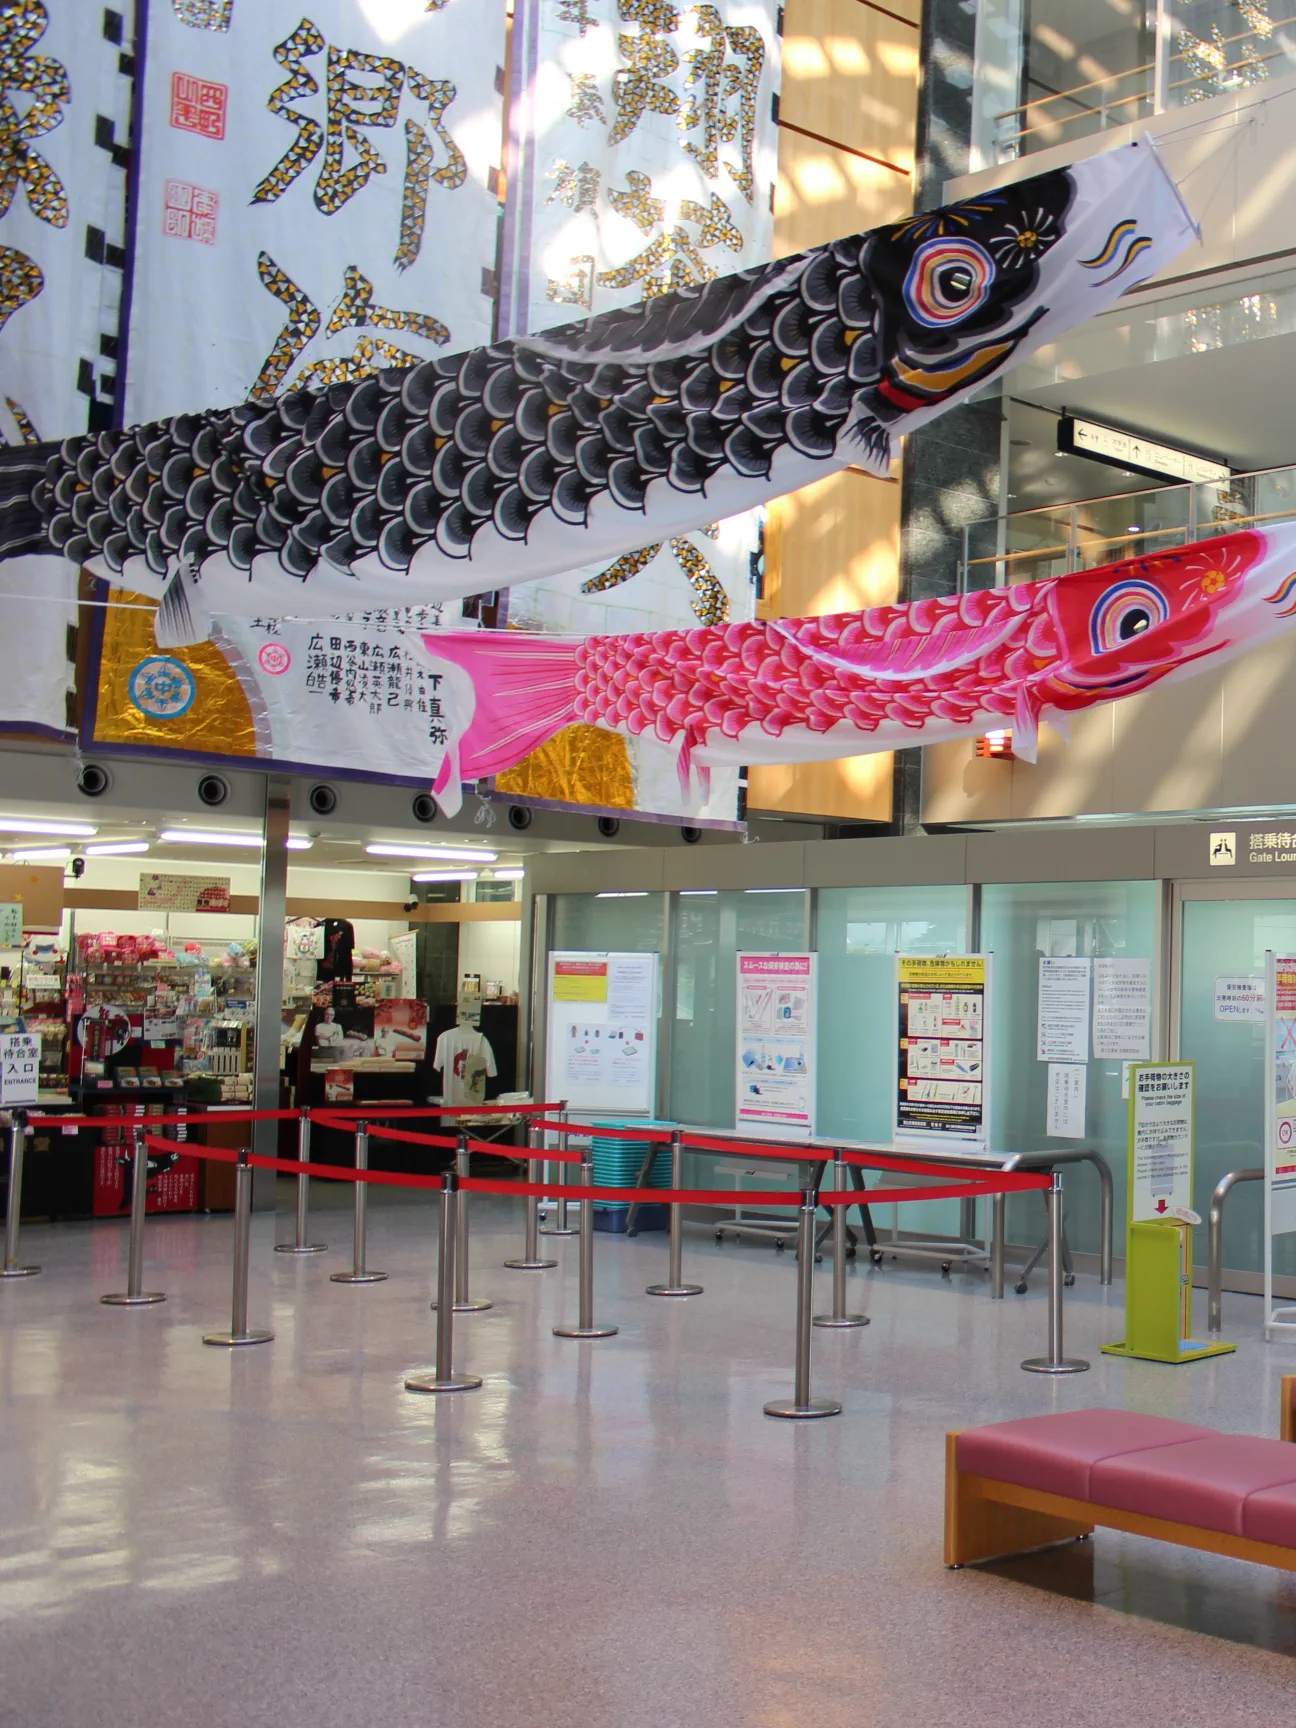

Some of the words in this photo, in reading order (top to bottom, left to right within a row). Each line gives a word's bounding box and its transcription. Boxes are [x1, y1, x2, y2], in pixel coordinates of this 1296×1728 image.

[1249, 852, 1273, 863] Gate
[10, 1036, 33, 1048] 搭乗
[3, 1047, 39, 1059] 待合室
[7, 1063, 34, 1074] 入口
[4, 1077, 37, 1085] ENTRANCE
[1138, 1071, 1190, 1082] お手荷物の大きさの
[1138, 1081, 1190, 1092] 確認をお願いします
